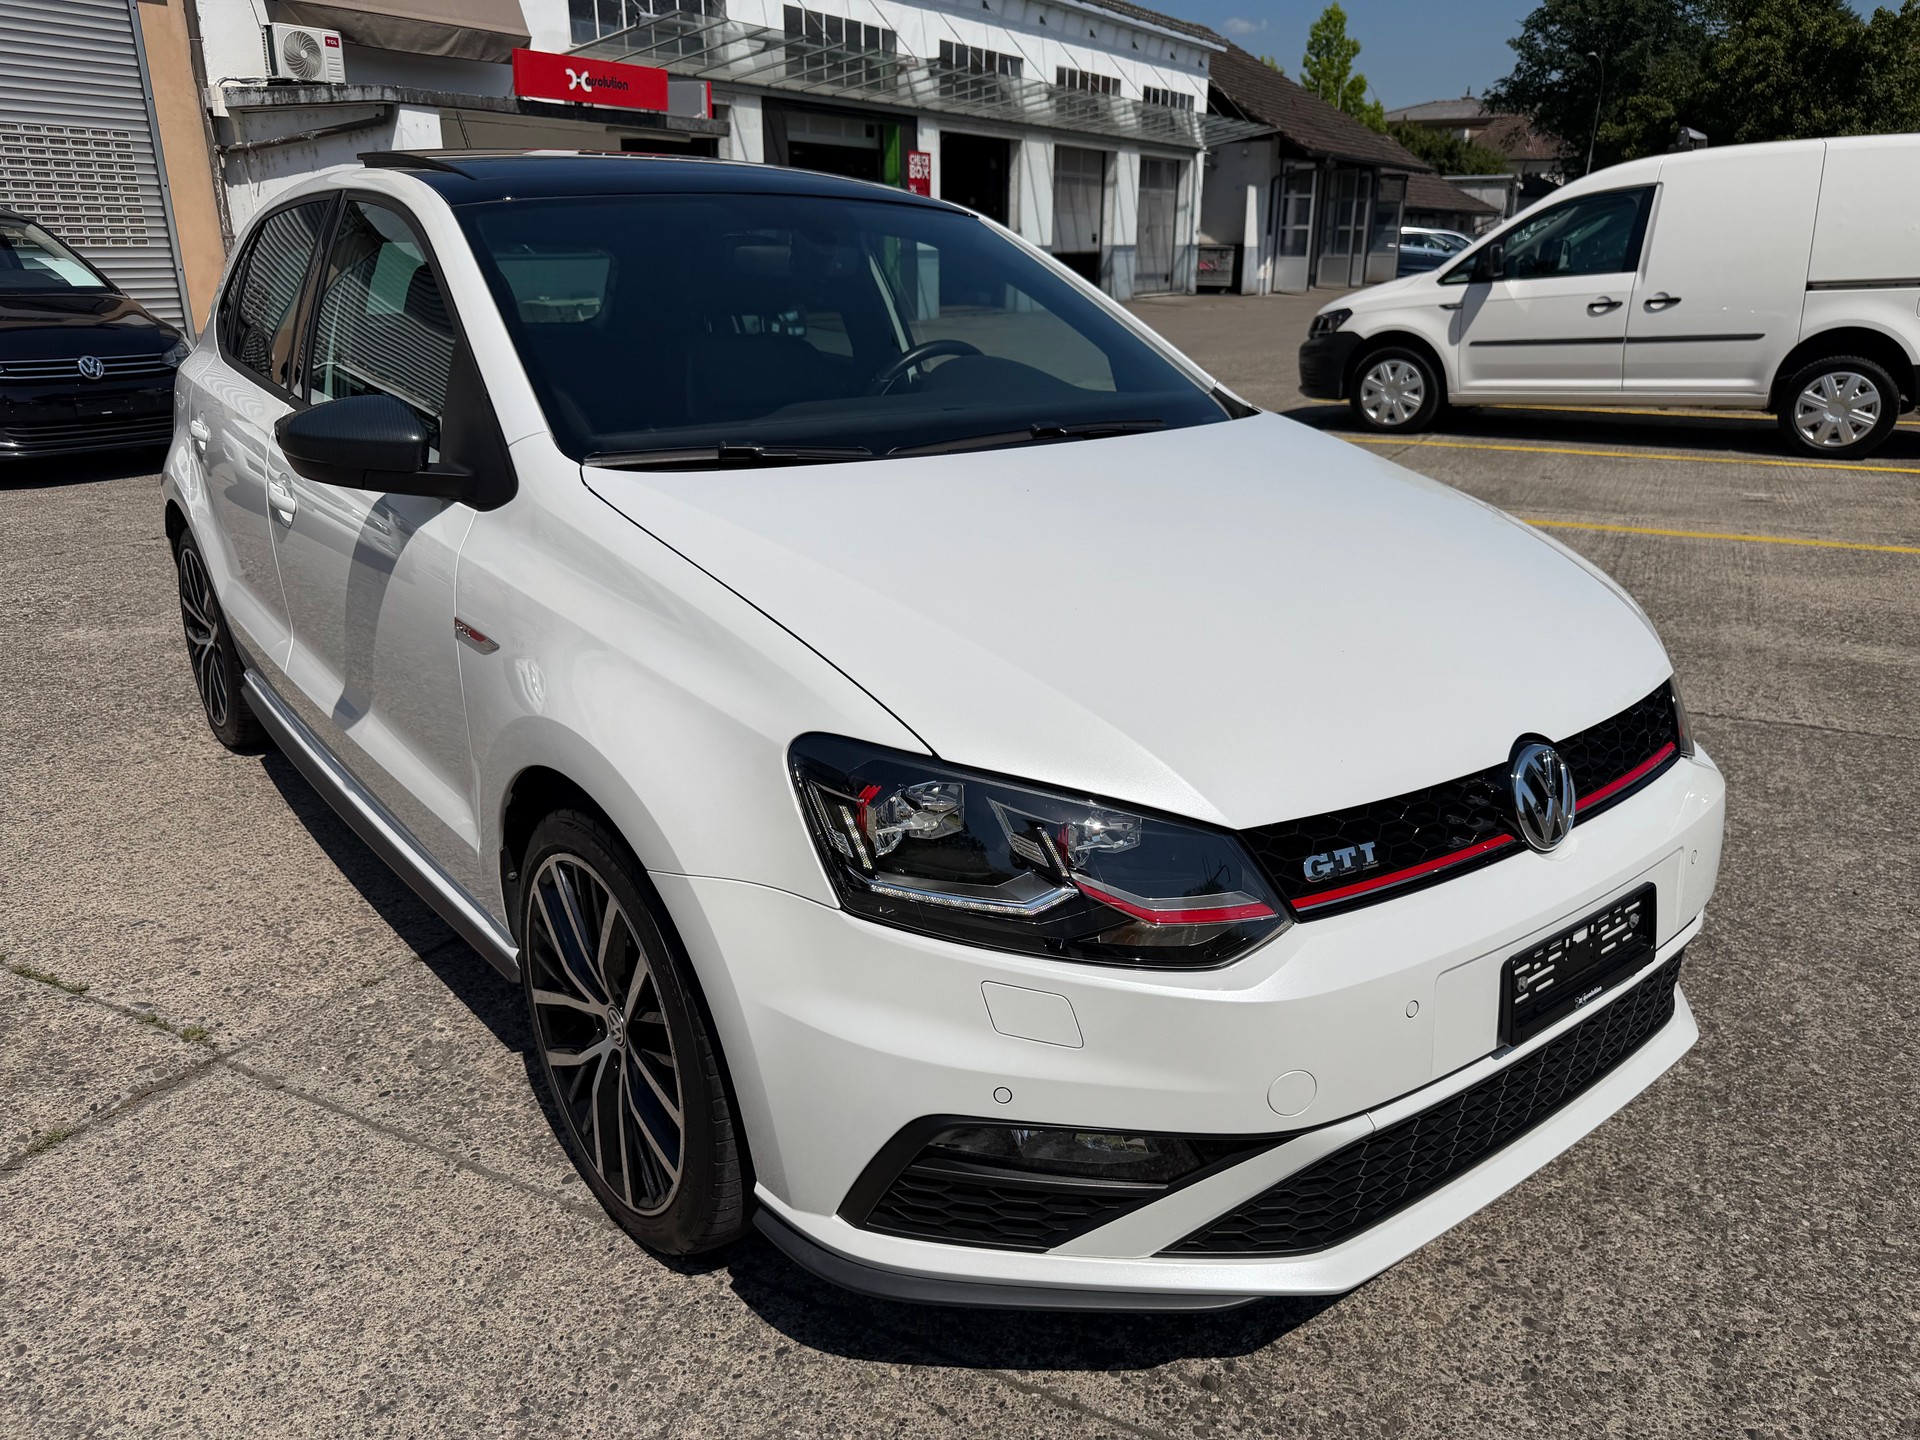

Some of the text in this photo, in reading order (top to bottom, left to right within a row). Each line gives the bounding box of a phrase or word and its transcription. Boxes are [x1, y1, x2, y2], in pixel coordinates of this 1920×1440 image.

[909, 164, 930, 179] BOX
[1512, 744, 1576, 851] VW
[1303, 841, 1379, 882] GTI
